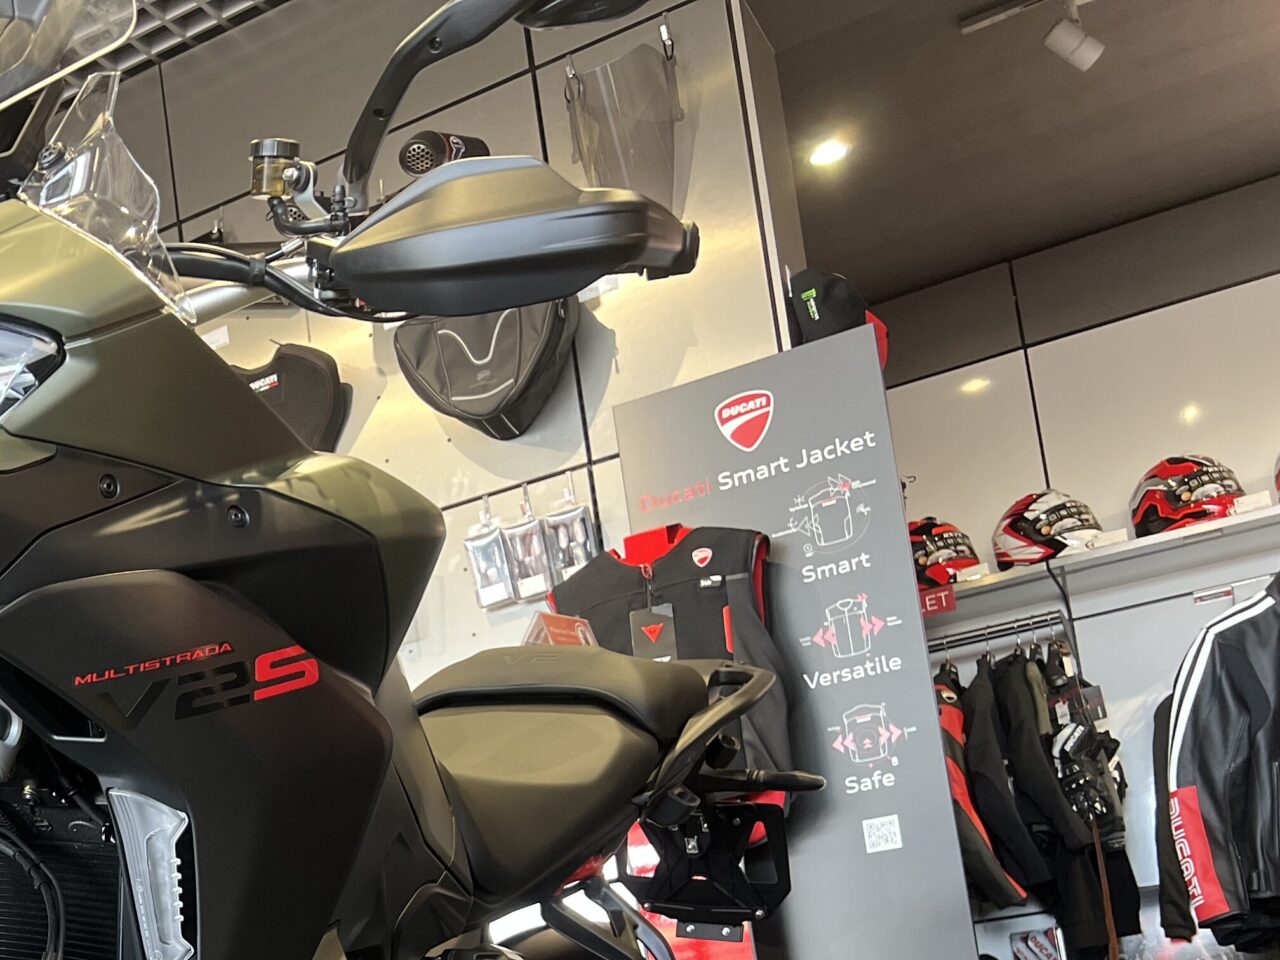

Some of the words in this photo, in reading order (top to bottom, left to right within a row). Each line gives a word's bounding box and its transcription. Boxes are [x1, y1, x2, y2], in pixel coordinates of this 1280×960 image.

[721, 396, 767, 419] DUCATI
[640, 476, 711, 513] Ducati
[718, 455, 791, 491] Smart
[796, 430, 877, 469] Jacket
[801, 551, 872, 583] Smart
[74, 642, 232, 687] MULTISTRADA
[803, 655, 902, 690] Versatile
[1064, 725, 1085, 752] DUCATI
[844, 770, 896, 794] Safe
